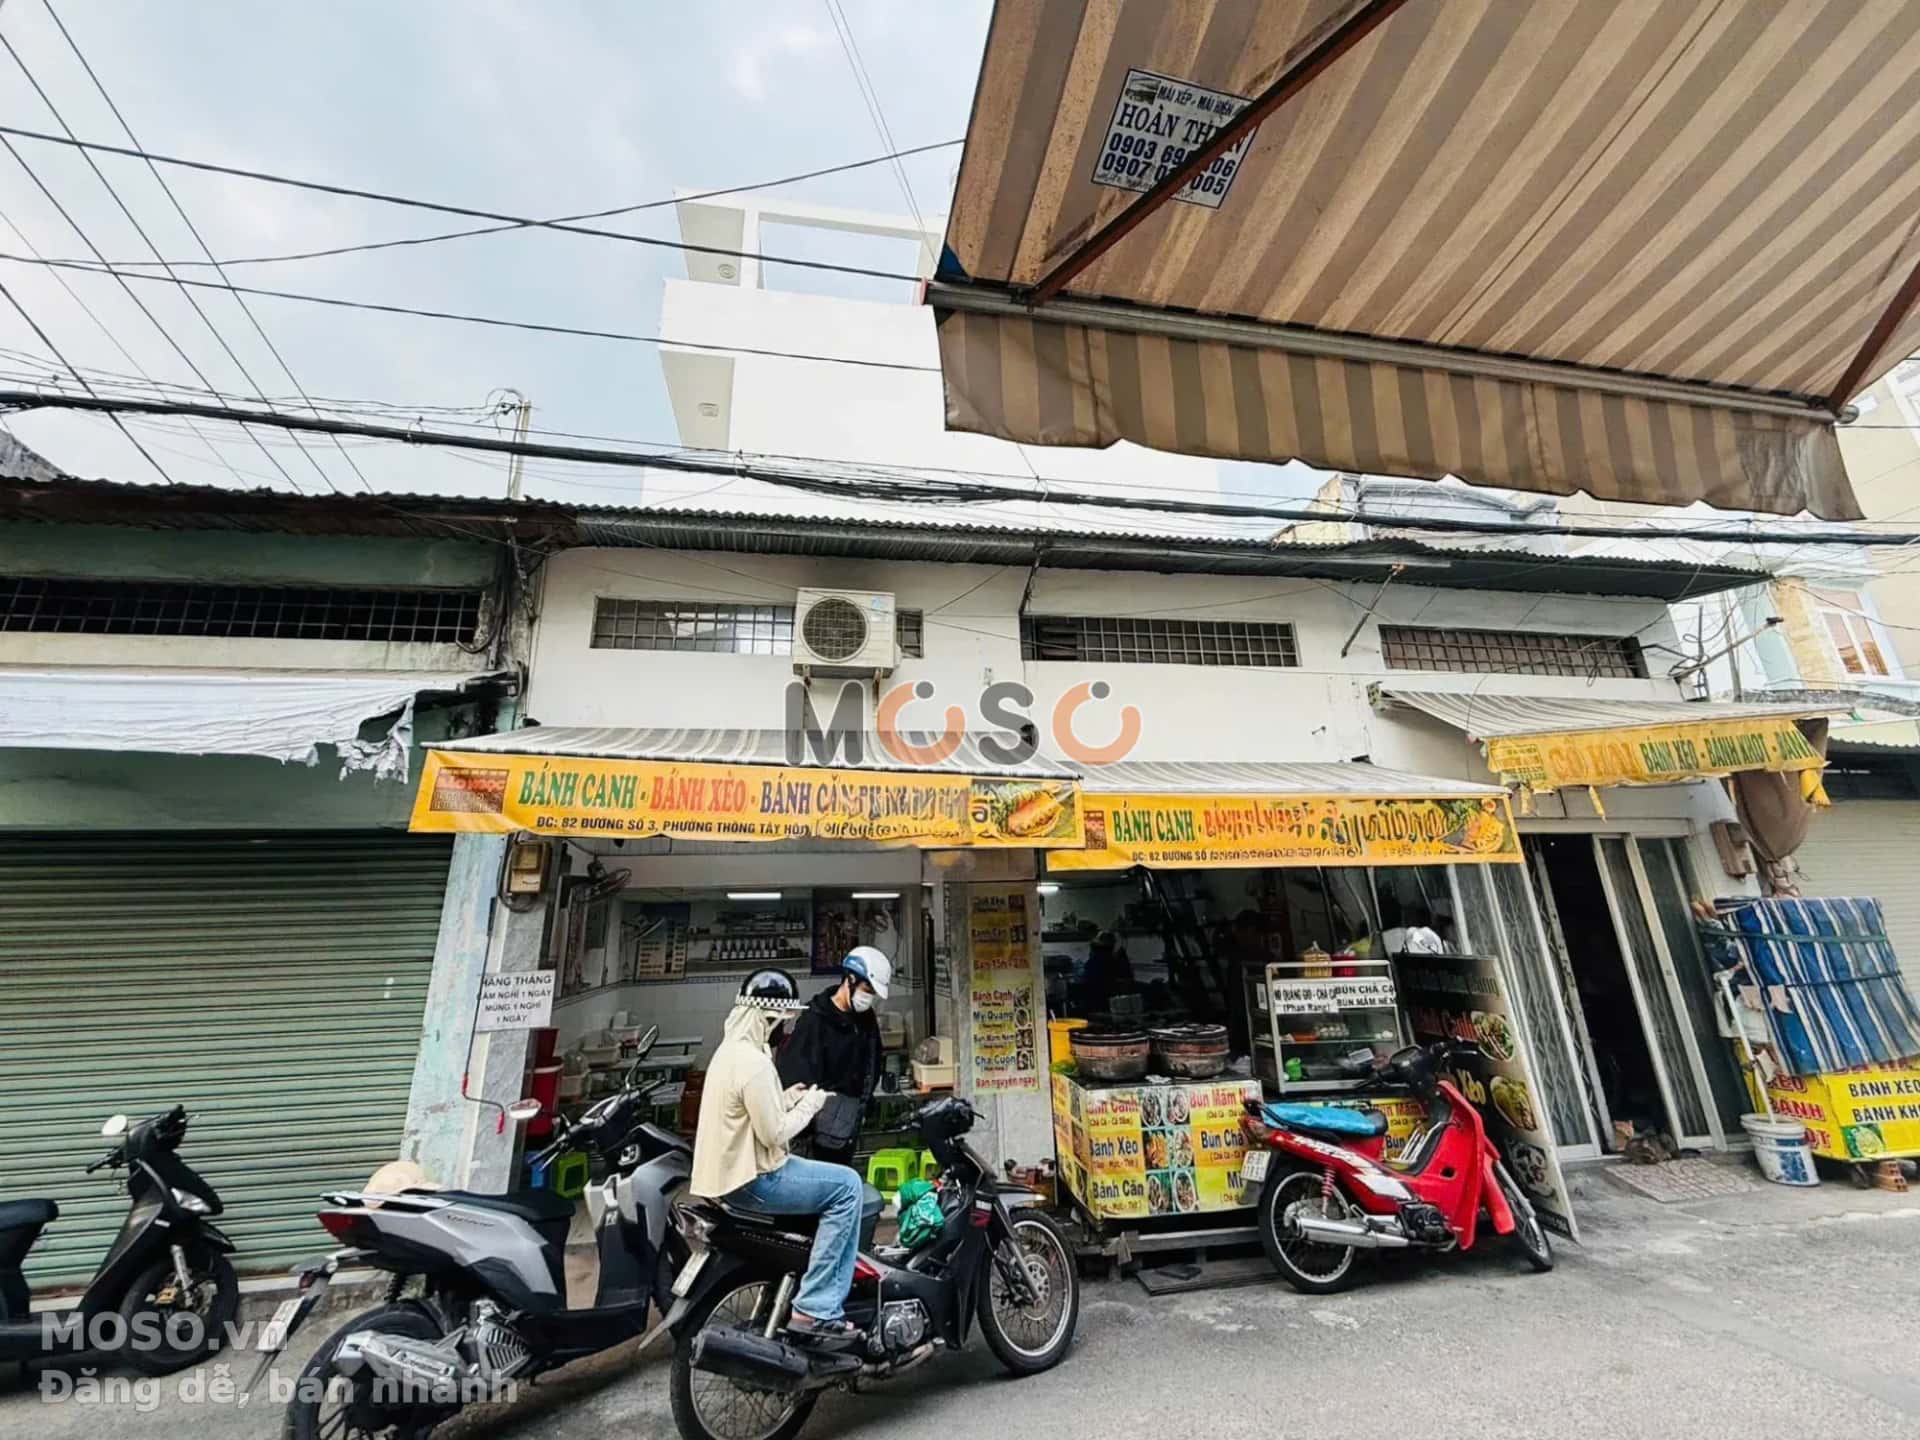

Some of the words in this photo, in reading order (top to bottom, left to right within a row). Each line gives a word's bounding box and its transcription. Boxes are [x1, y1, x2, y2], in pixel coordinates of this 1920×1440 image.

[1117, 103, 1180, 138] HOÀN
[1109, 132, 1158, 160] 0903
[1102, 152, 1151, 179] 0907
[518, 761, 579, 806] BÁNH
[582, 773, 638, 809] CANH
[649, 767, 706, 811] BÁNH
[760, 772, 812, 814] BÁNH
[1112, 801, 1153, 841] BÁNH
[1156, 810, 1195, 842] CANH
